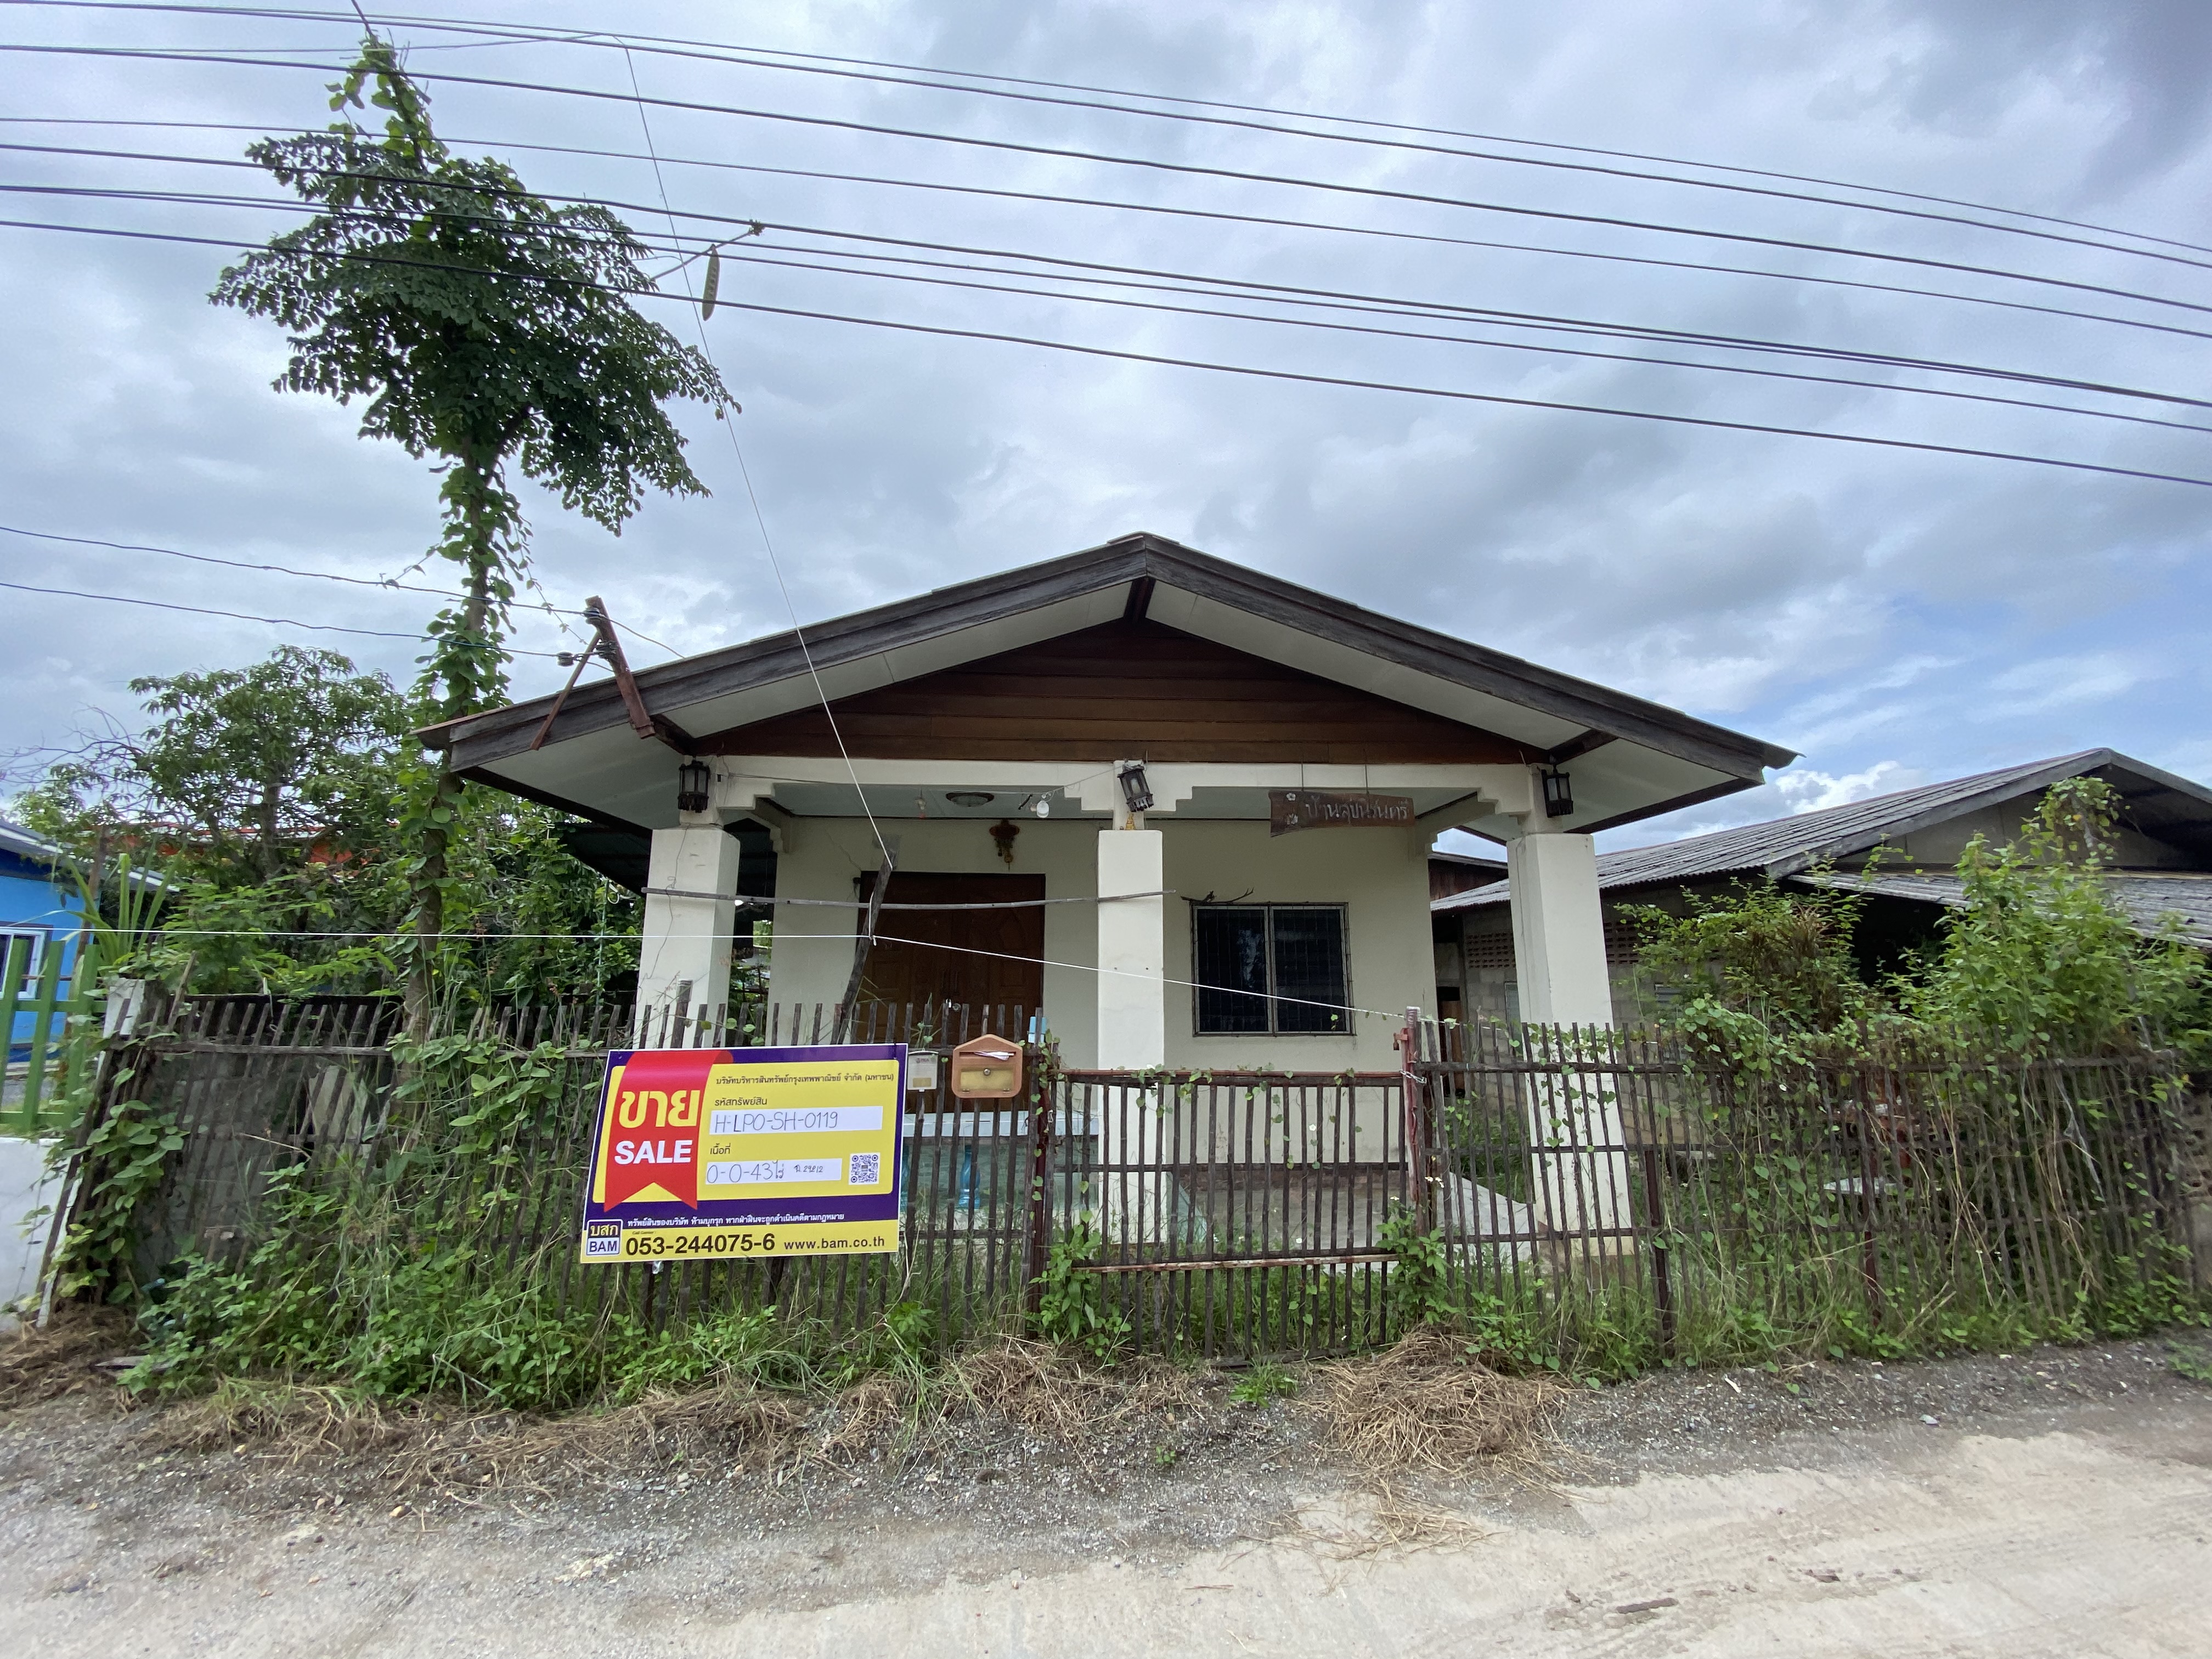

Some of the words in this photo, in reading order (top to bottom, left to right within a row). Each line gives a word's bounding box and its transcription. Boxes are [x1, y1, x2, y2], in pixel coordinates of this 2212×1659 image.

[844, 1073, 862, 1081] จำกัด
[865, 1073, 894, 1082] (มหาชน)
[714, 1097, 767, 1107] รหัสทรัพย์สิน
[619, 1090, 701, 1128] ขาย
[614, 1139, 693, 1165] SALE
[710, 1143, 731, 1154] เนื้อที่
[628, 1217, 689, 1227] ทรัพย์สินของบริษัท
[691, 1216, 723, 1227] ห้ามบุกรุก
[590, 1224, 618, 1237] บสก
[589, 1240, 617, 1252] BAM
[626, 1233, 775, 1256] 053-244075-6
[784, 1236, 885, 1250] www.bam.co.th
